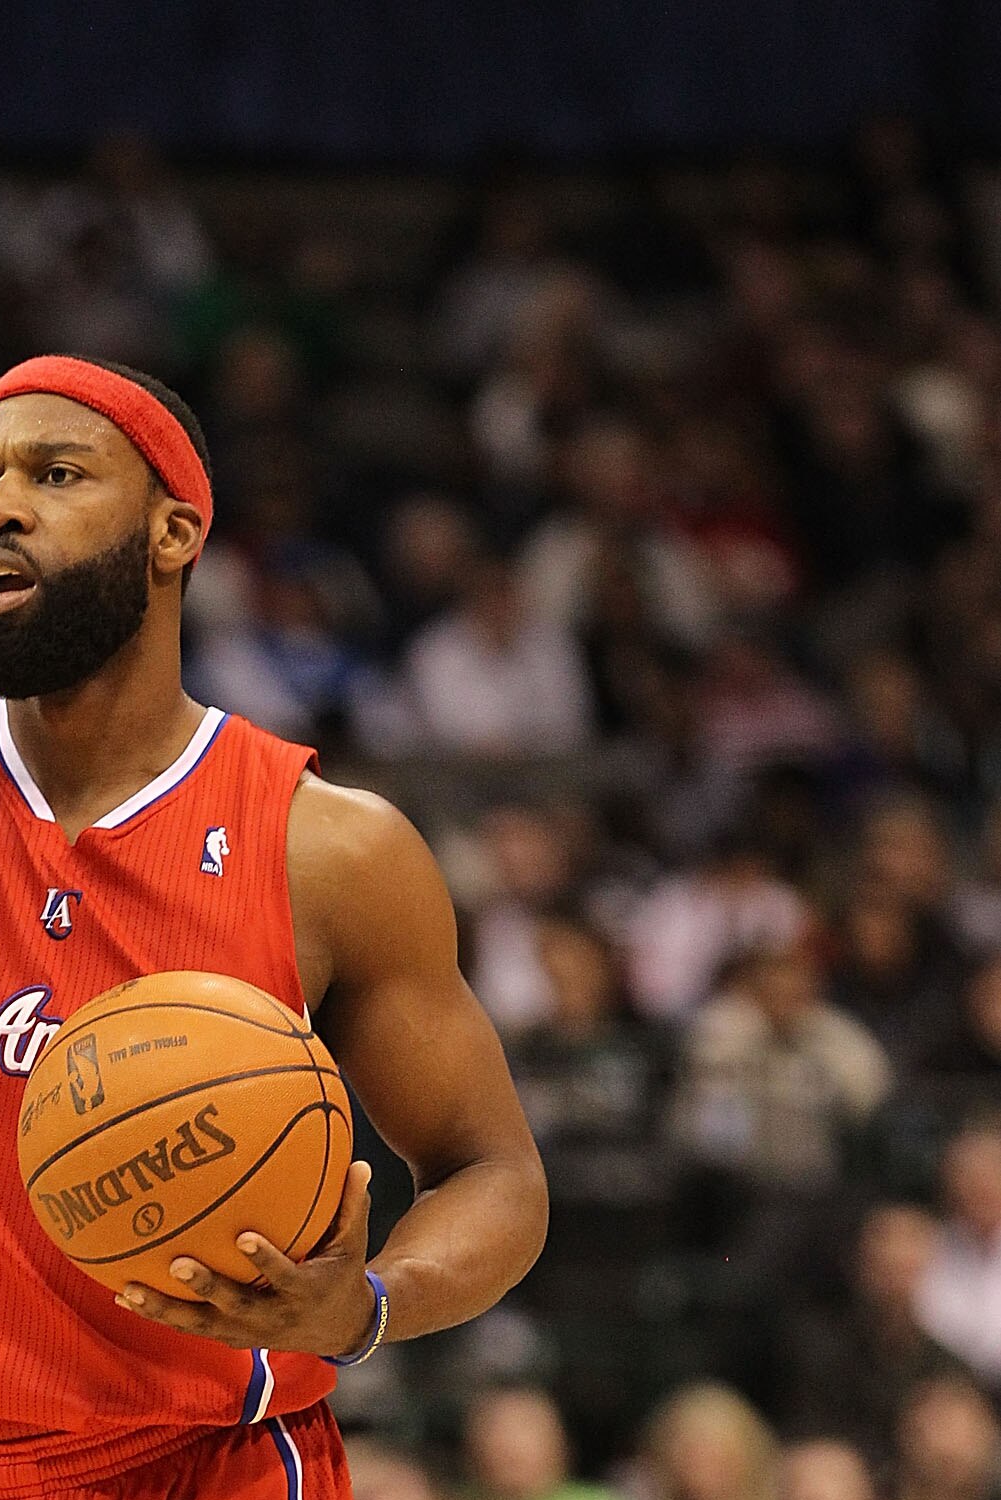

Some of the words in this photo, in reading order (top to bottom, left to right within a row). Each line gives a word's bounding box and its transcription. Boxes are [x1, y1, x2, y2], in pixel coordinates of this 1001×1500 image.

[200, 861, 220, 875] NBA
[37, 1102, 236, 1240] SPALDING
[373, 1296, 388, 1345] WOODEN
